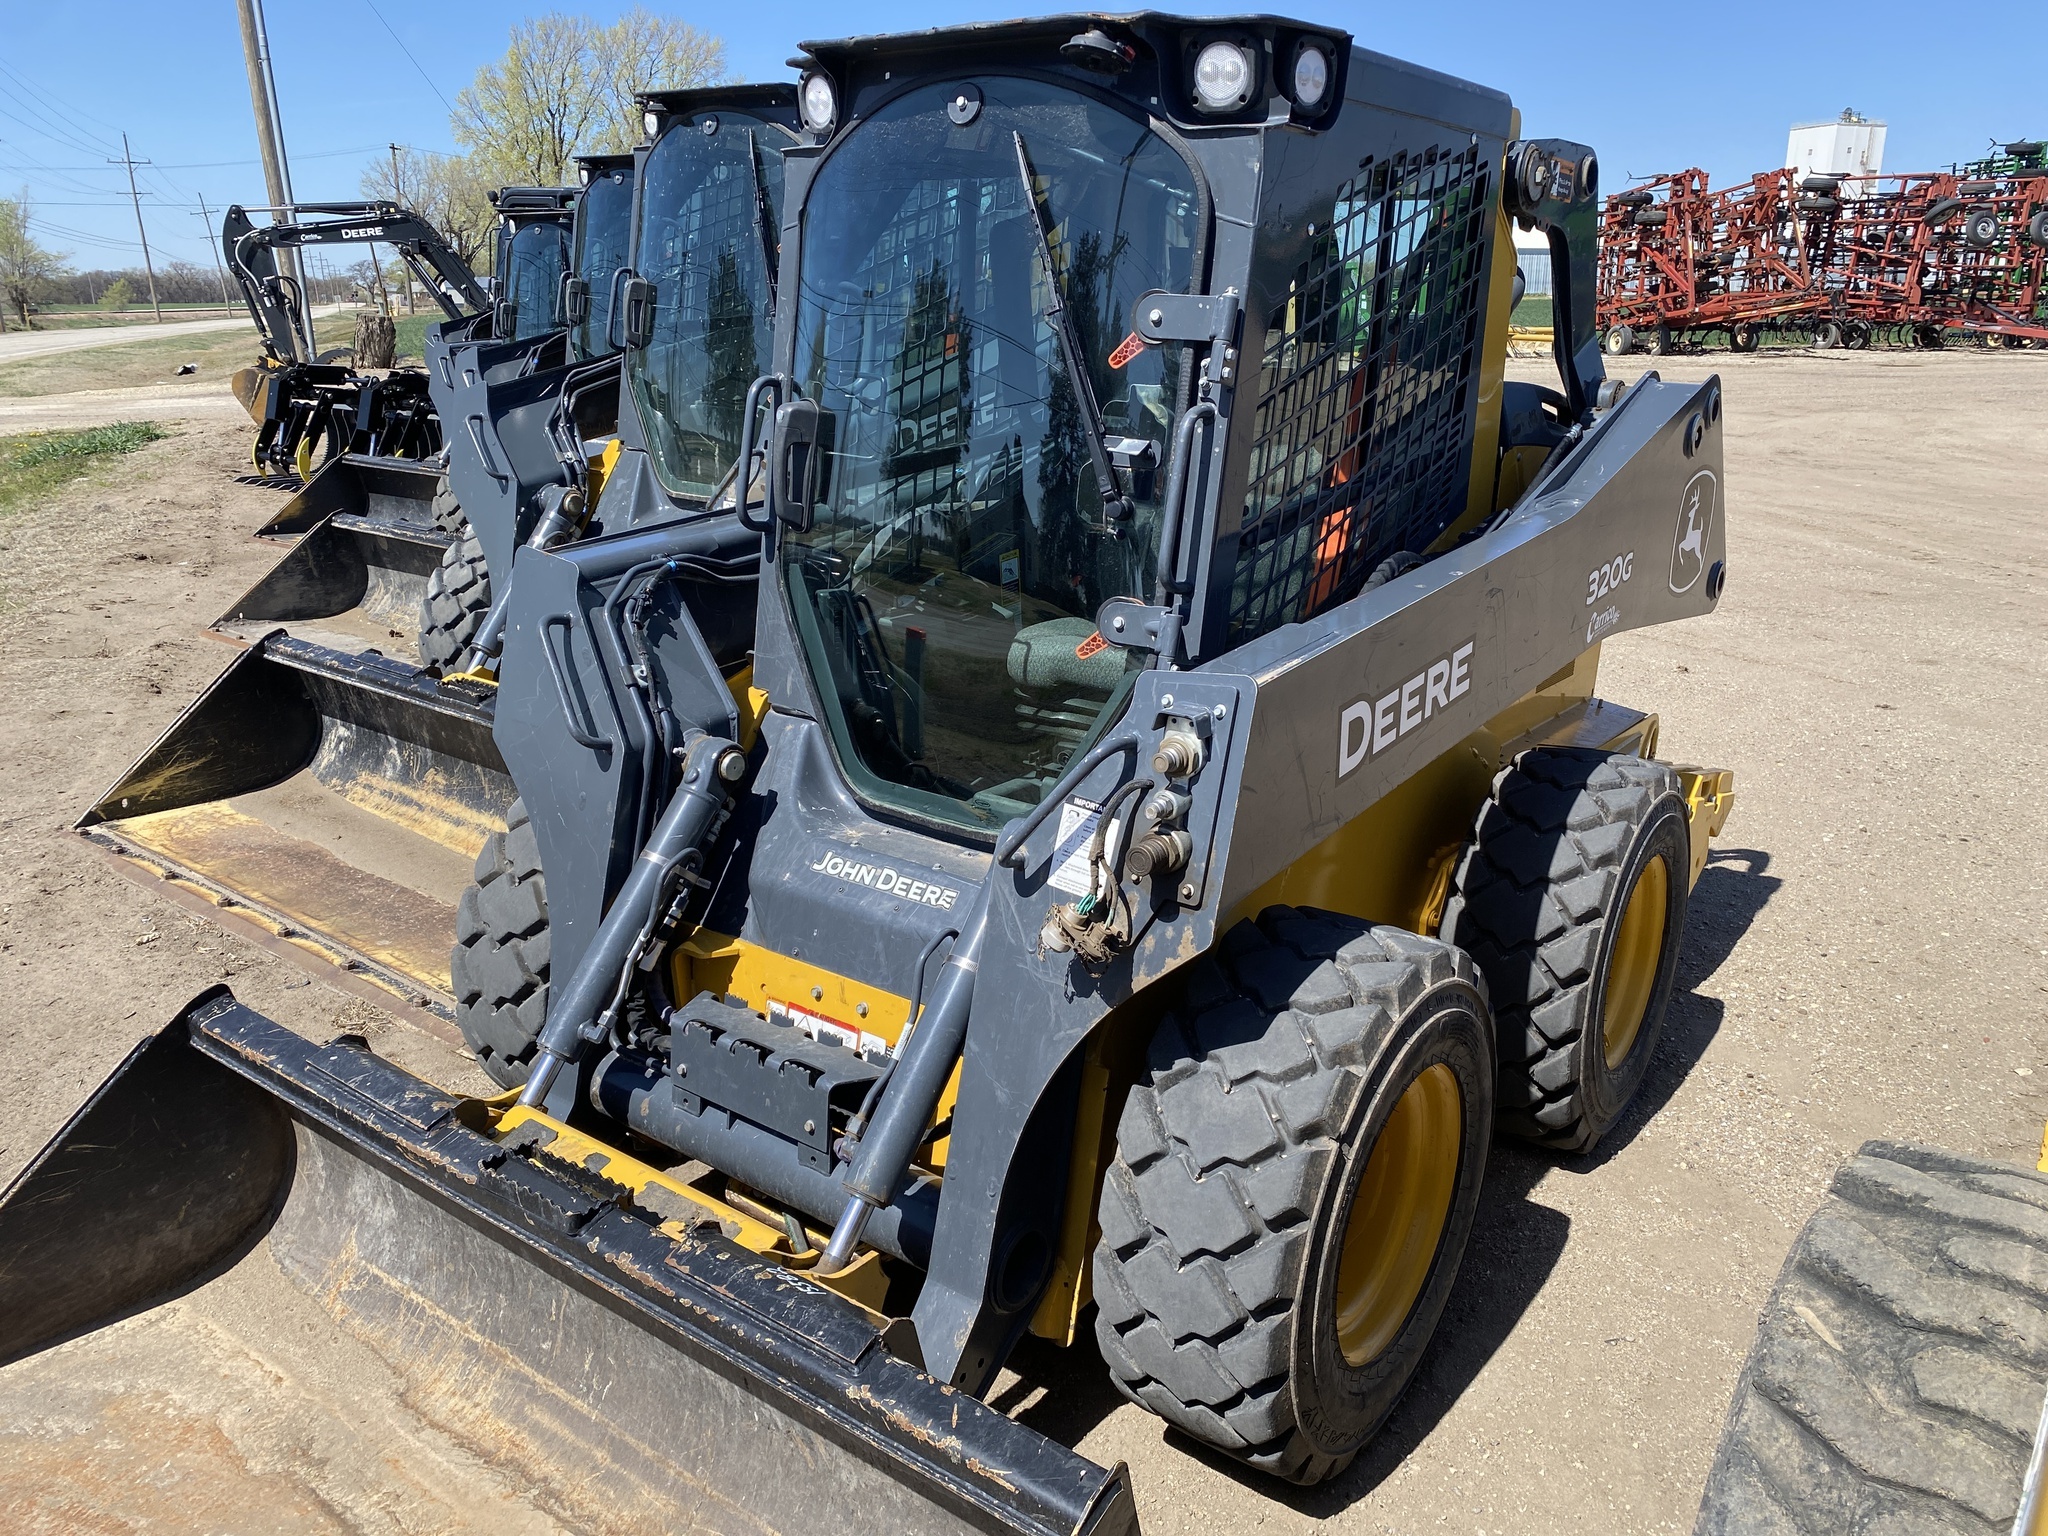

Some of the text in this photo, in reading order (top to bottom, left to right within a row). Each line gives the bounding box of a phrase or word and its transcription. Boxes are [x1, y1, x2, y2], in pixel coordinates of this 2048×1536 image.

[341, 227, 384, 239] DEERE
[1586, 552, 1634, 605] 320G
[1586, 605, 1616, 643] Carrico
[1338, 641, 1473, 779] DEERE
[1074, 797, 1106, 813] IMPORTA
[812, 850, 958, 910] JOHN DEERE
